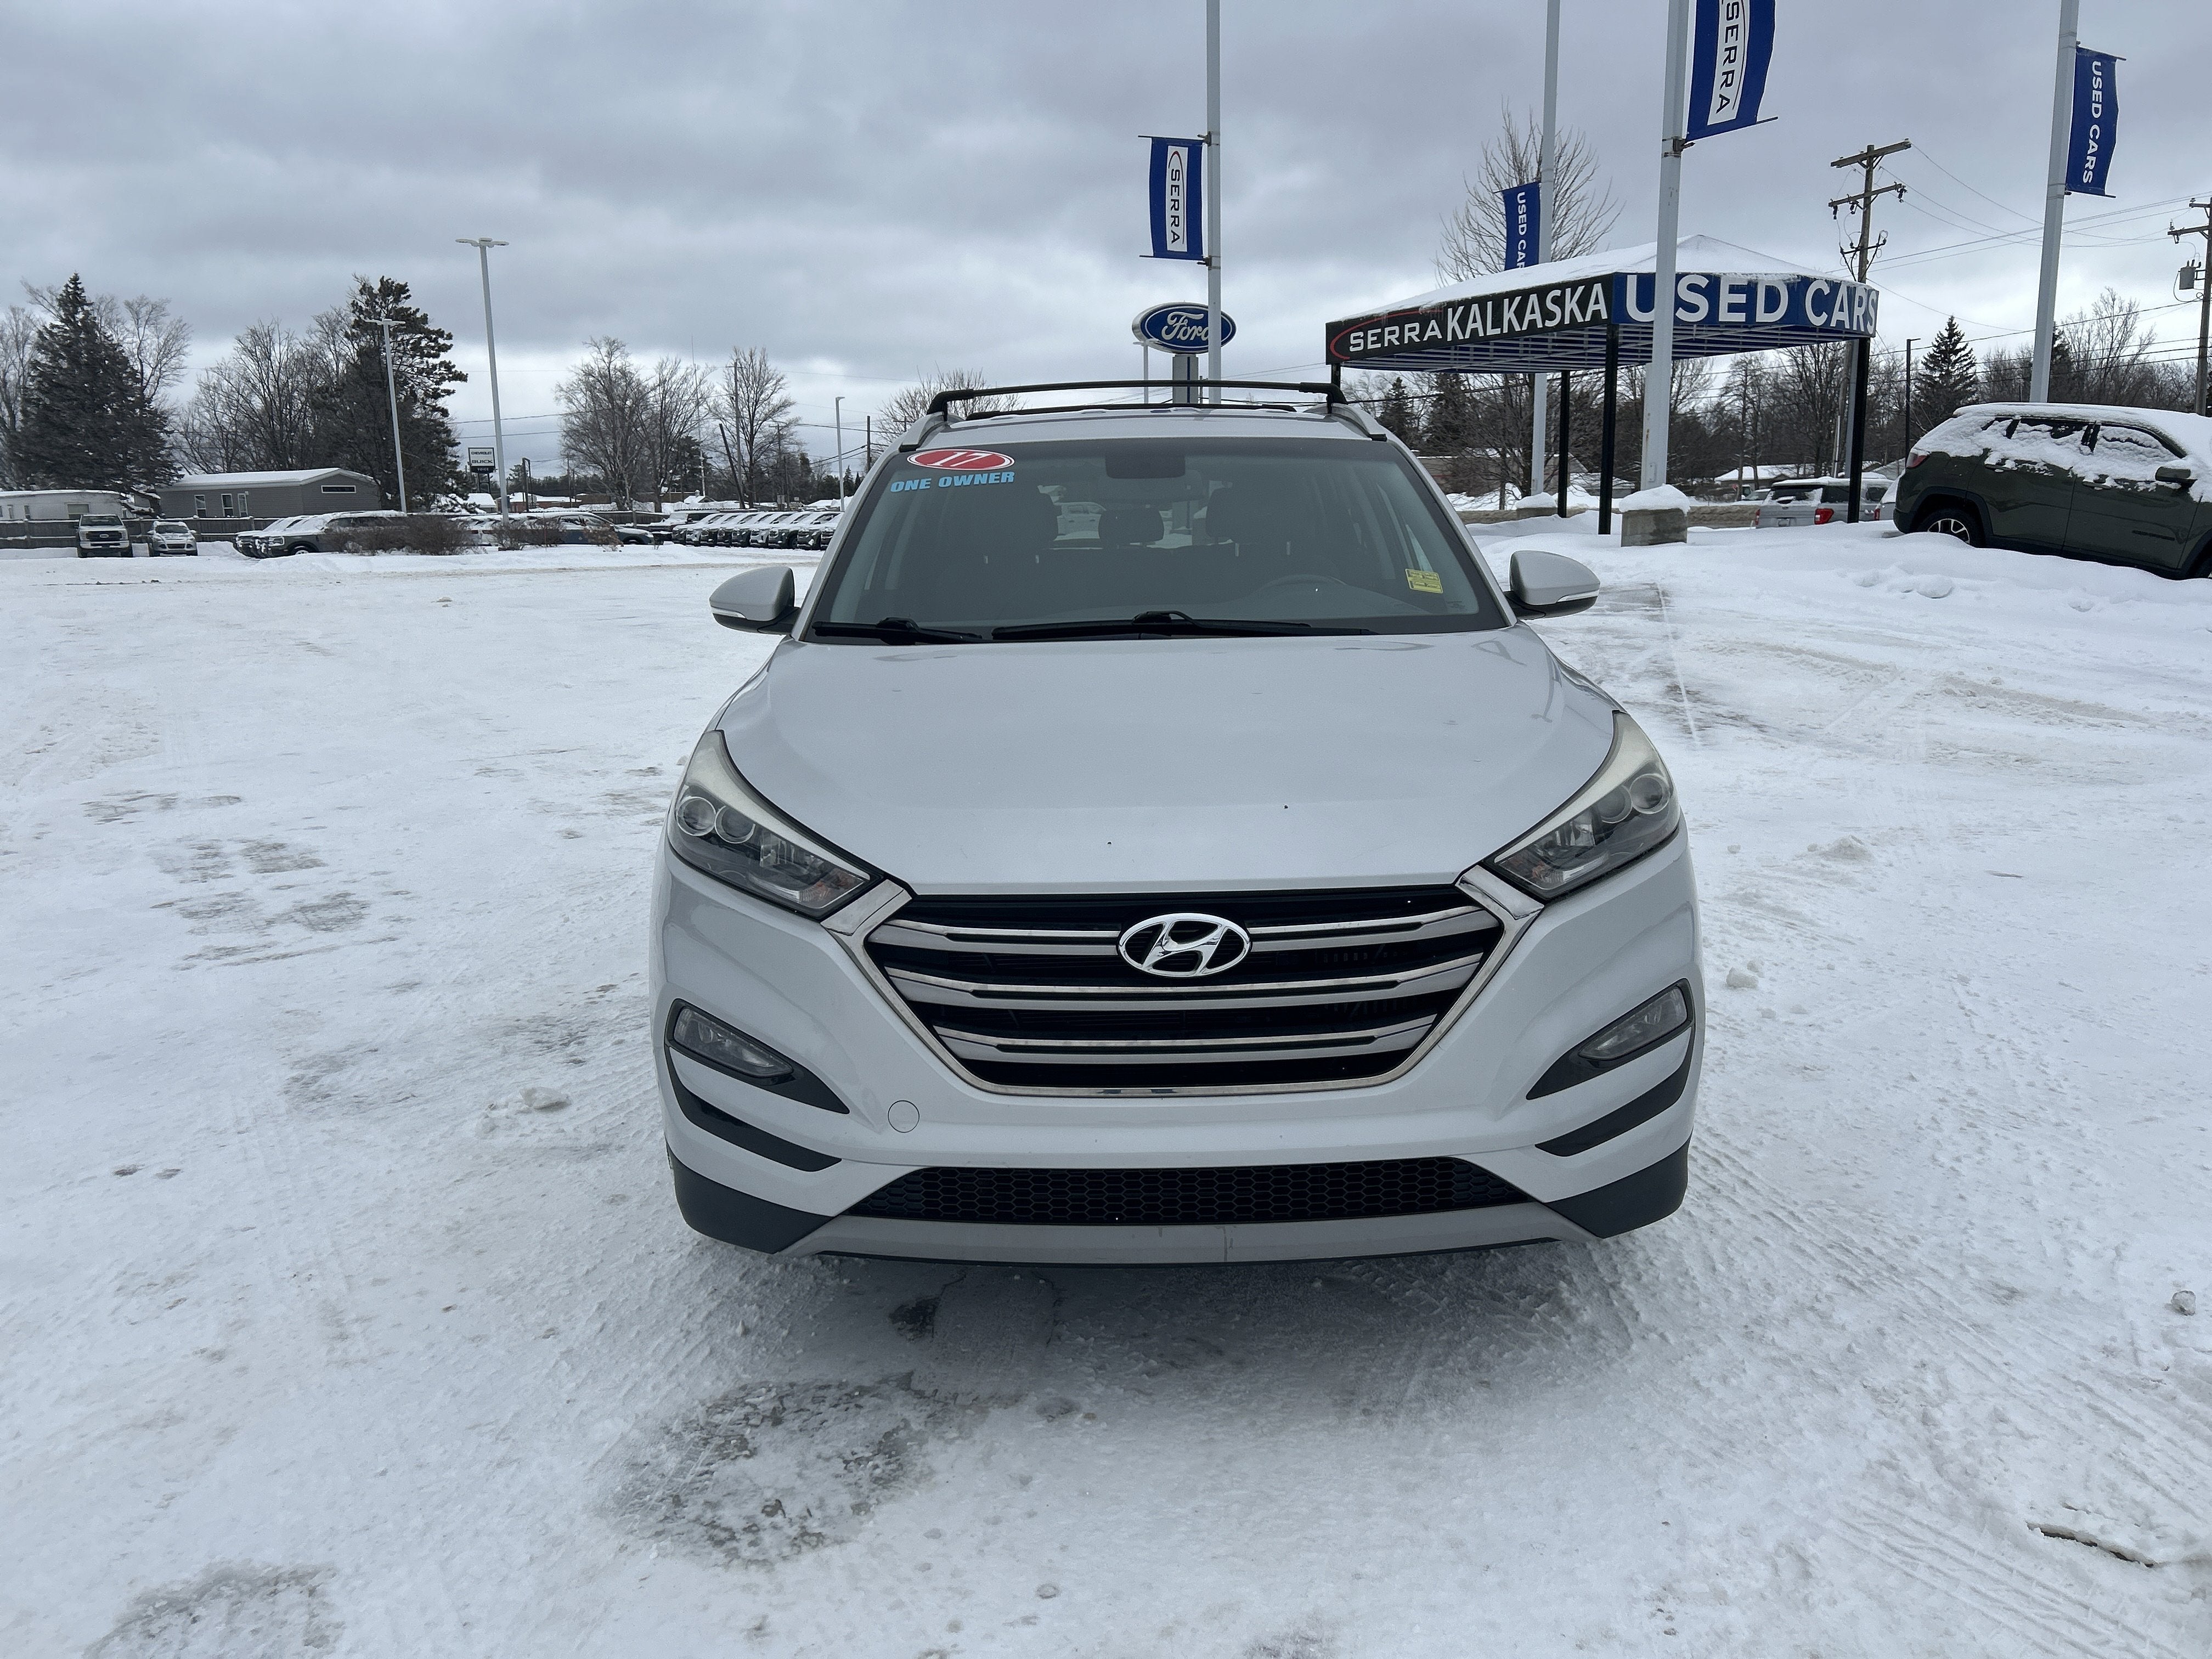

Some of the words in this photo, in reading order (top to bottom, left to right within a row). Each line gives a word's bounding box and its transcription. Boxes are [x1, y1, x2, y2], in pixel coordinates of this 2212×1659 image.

[1716, 2, 1739, 114] SERRA
[2091, 61, 2102, 119] USED
[2083, 124, 2100, 183] CARS
[1170, 168, 1180, 244] SERRA
[1517, 192, 1527, 235] USED
[1517, 239, 1526, 268] CAR
[1349, 319, 1443, 352] SERRA
[1447, 283, 1608, 341] KALKASKA
[1626, 274, 1789, 323] USED
[1805, 279, 1876, 335] CARS
[890, 478, 932, 492] ONE
[938, 471, 1015, 488] OWNER
[927, 452, 994, 467] 17
